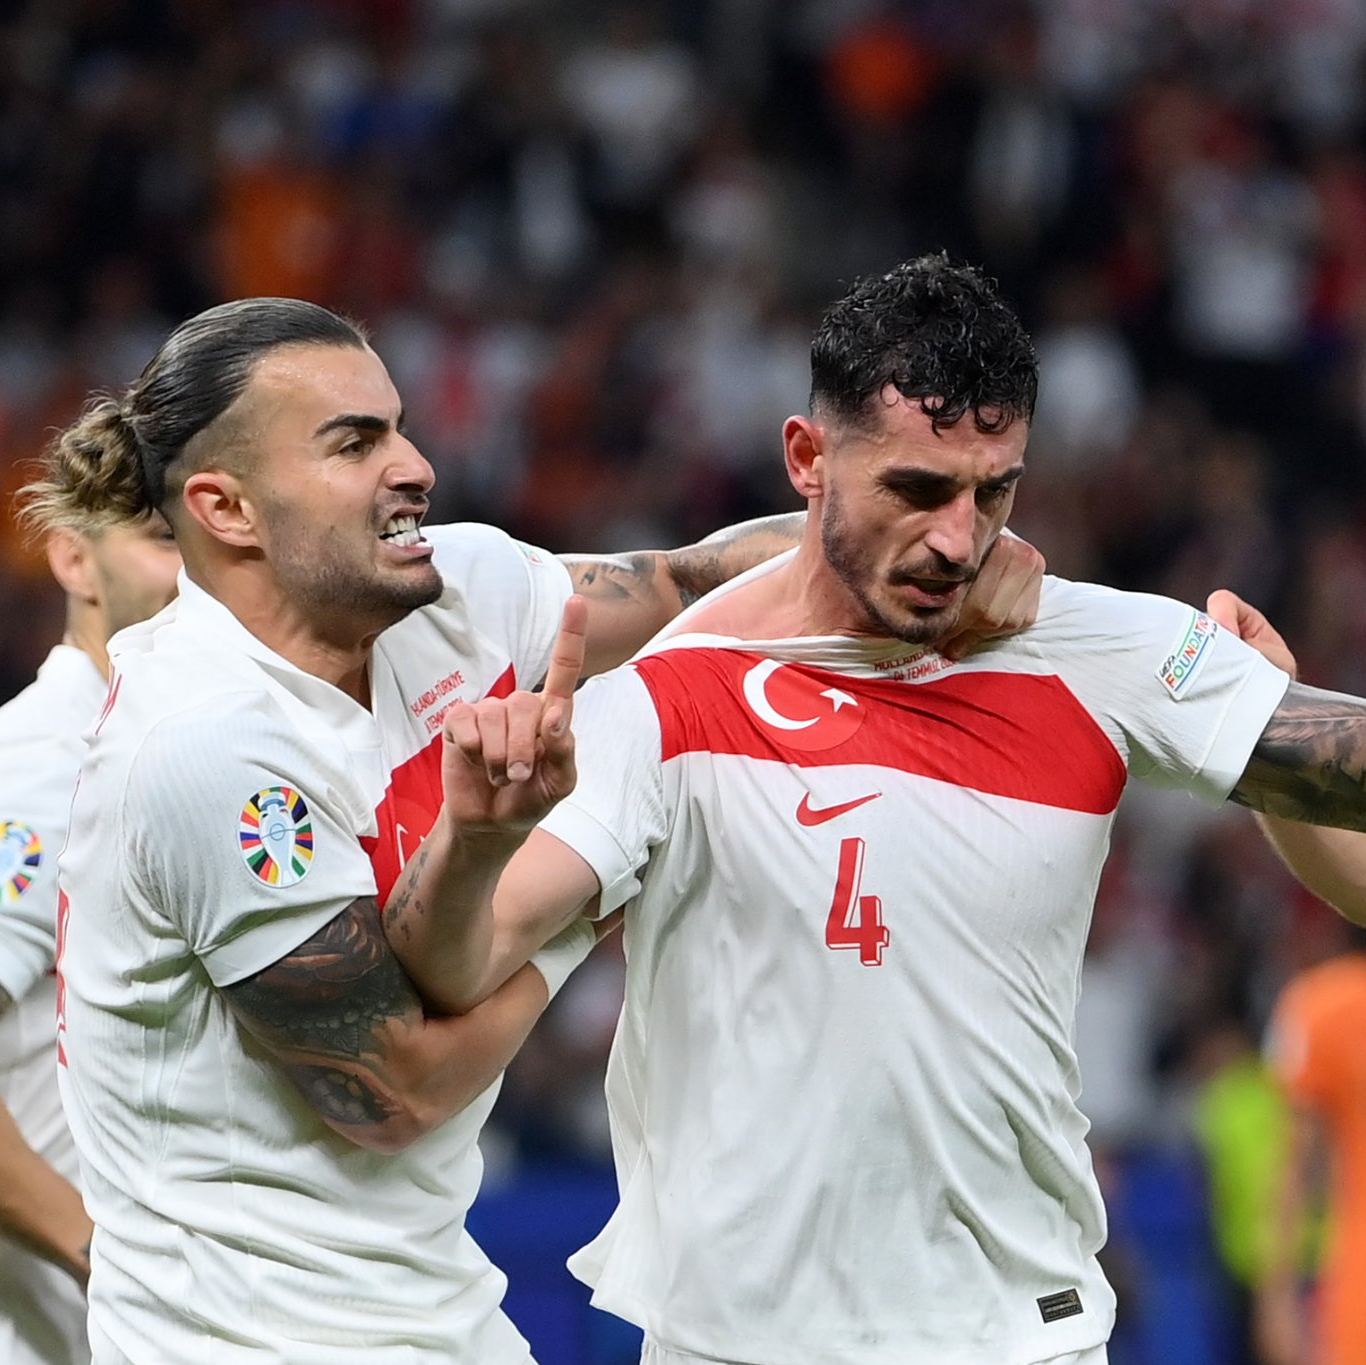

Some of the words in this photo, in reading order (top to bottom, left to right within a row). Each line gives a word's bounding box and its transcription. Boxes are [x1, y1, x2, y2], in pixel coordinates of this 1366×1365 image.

[907, 662, 941, 680] TEMMUZ
[1159, 655, 1176, 678] UEFA
[825, 836, 890, 967] 4
